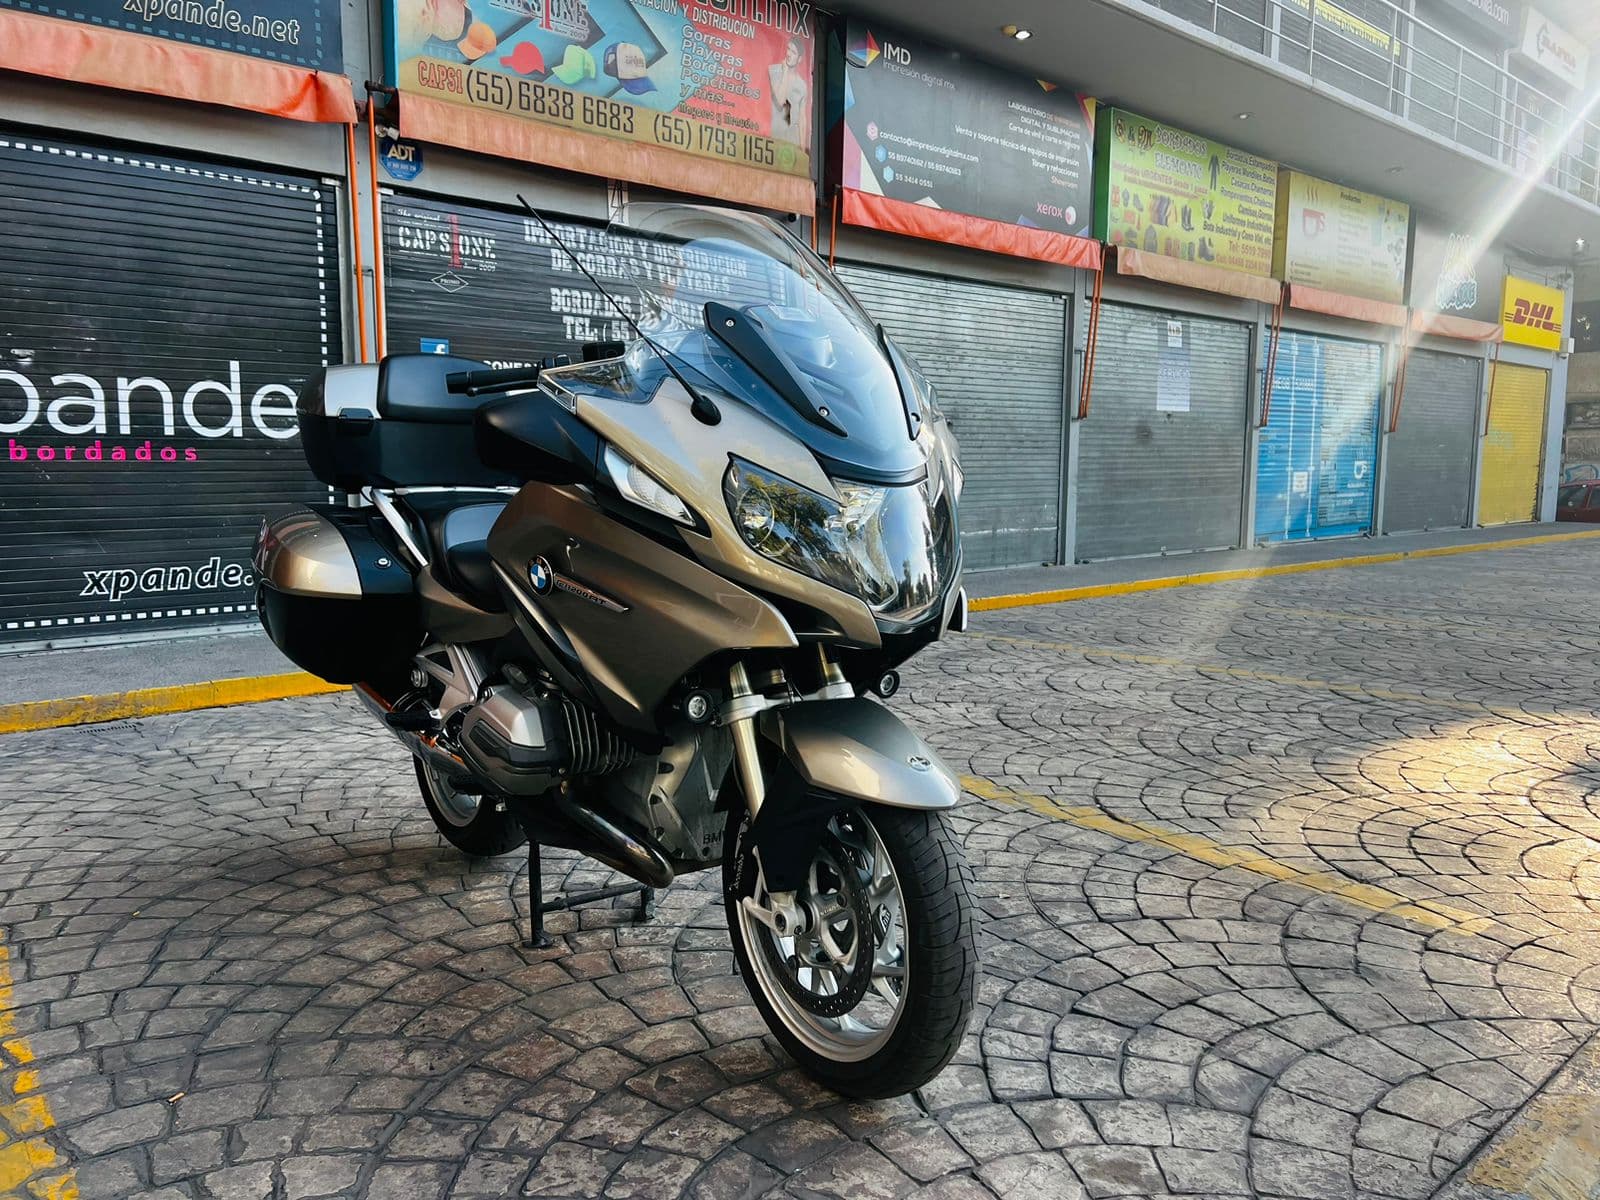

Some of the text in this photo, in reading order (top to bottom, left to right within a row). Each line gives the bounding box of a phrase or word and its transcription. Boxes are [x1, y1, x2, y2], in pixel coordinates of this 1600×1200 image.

[124, 0, 300, 45] xpande.net
[682, 3, 689, 18] Y
[682, 25, 732, 50] Gorras
[681, 39, 743, 67] Playeras
[884, 42, 911, 66] IMD
[681, 53, 751, 83] Bordados
[681, 67, 761, 99] Ponchados
[466, 69, 513, 110] (55)
[518, 81, 574, 121] 6838
[583, 96, 634, 134] 6683
[653, 114, 692, 150] (55)
[699, 124, 737, 158] 1793
[743, 135, 774, 166] 1155
[387, 144, 416, 162] ADT
[1036, 201, 1063, 218] xerox
[550, 249, 572, 272] DE
[1511, 297, 1560, 332] DHL
[9, 439, 199, 462] bordados
[80, 556, 253, 602] xpande.
